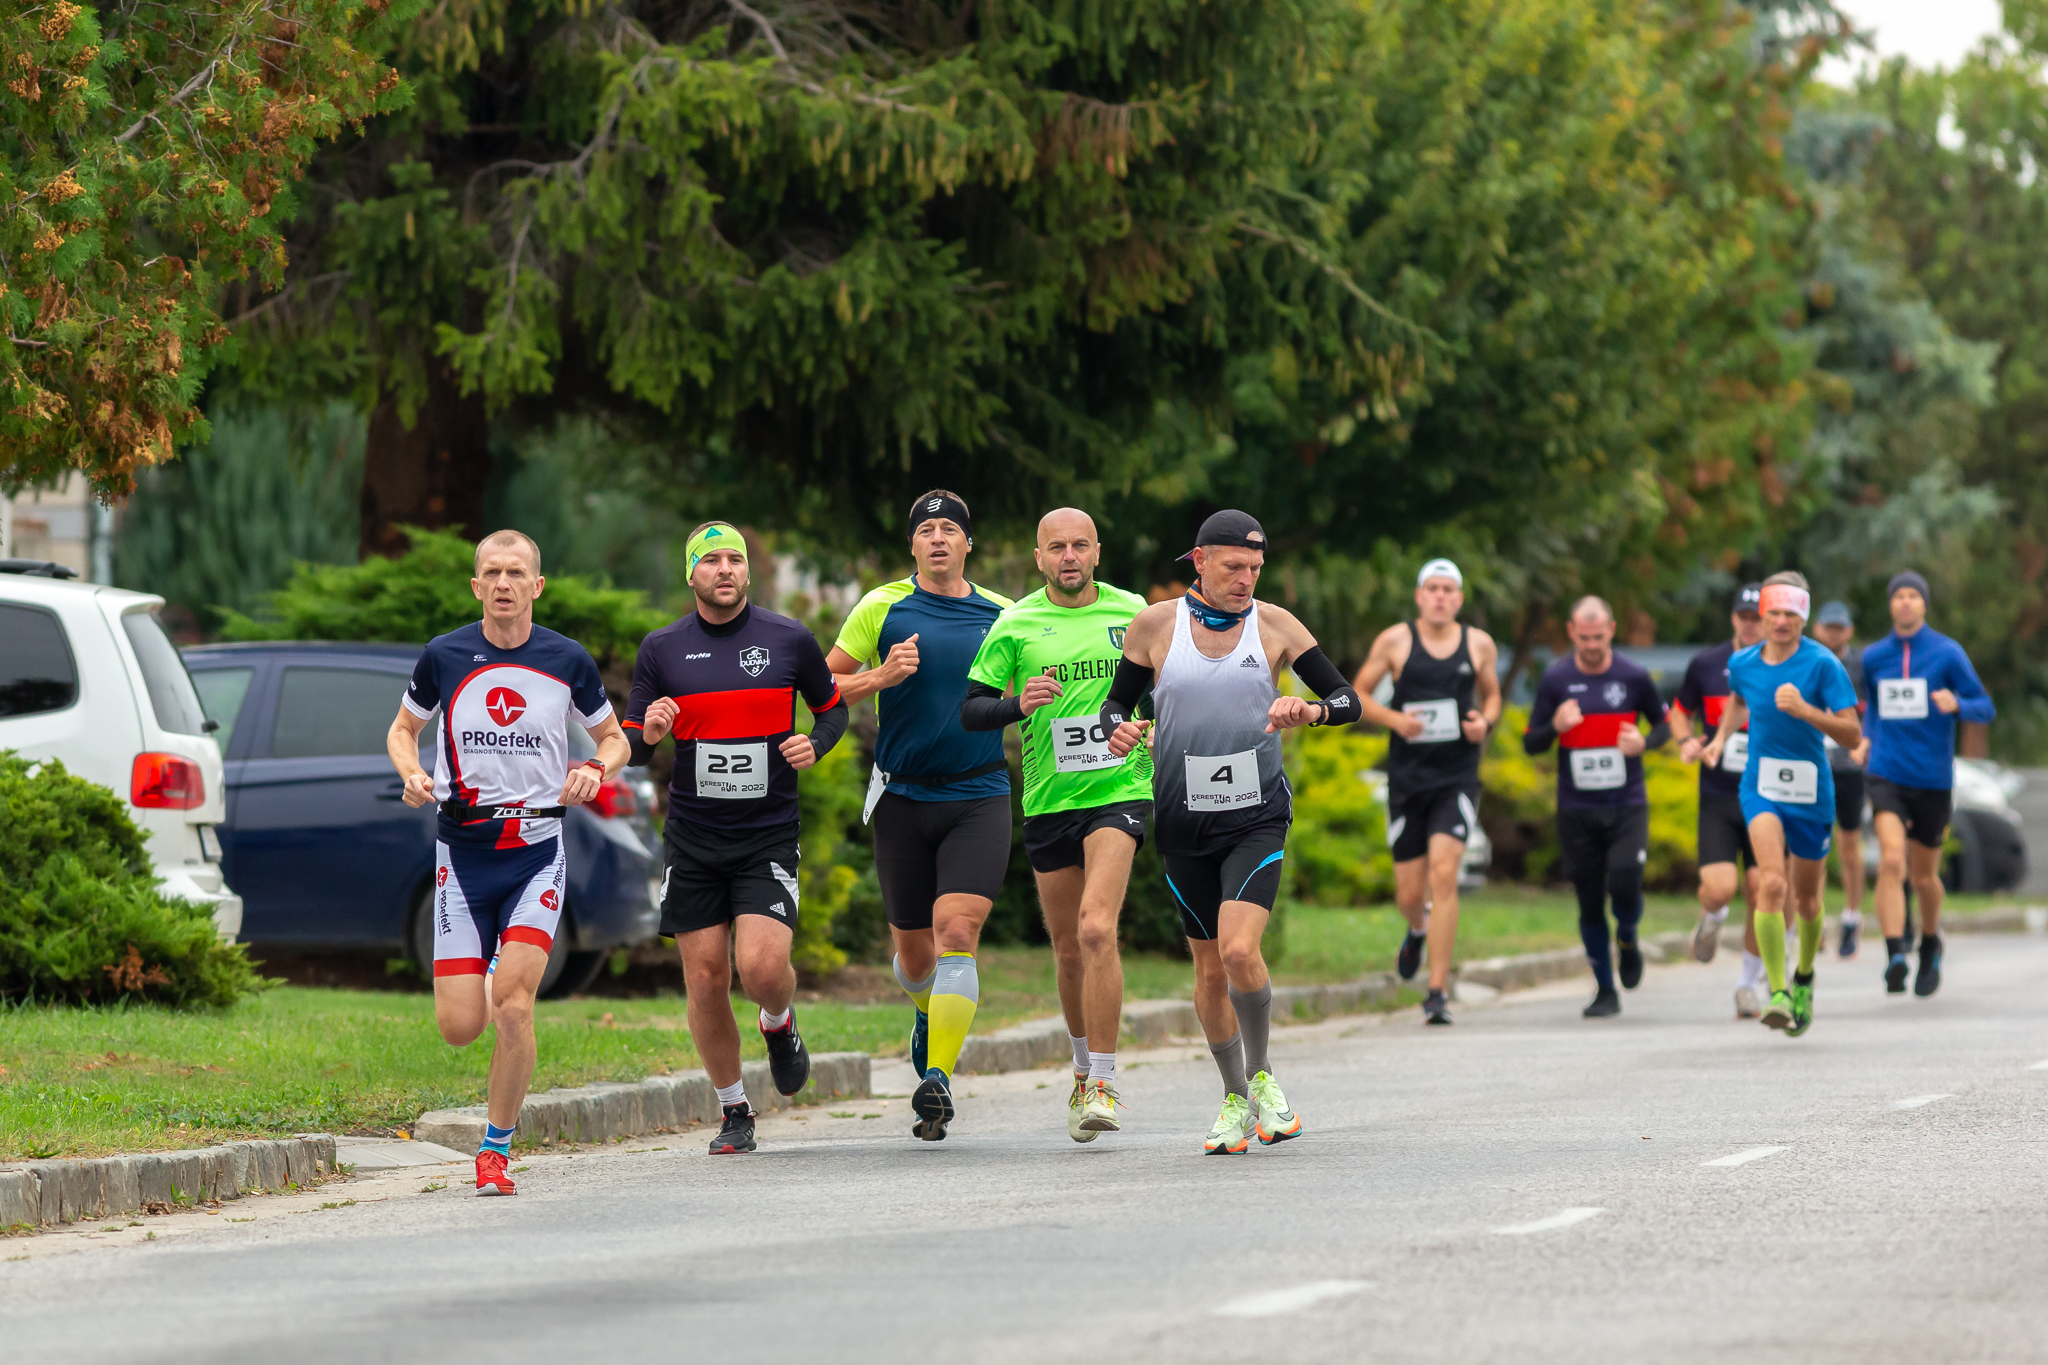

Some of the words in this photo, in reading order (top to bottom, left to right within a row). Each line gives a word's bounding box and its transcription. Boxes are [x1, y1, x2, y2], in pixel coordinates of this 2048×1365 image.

[462, 731, 541, 748] PROefekt
[1064, 724, 1106, 746] 30
[708, 754, 752, 774] 22
[1210, 765, 1233, 784] 4
[1779, 769, 1794, 782] 6
[741, 783, 765, 791] 2022
[1235, 790, 1258, 802] 2022
[439, 889, 452, 935] PROefekt
